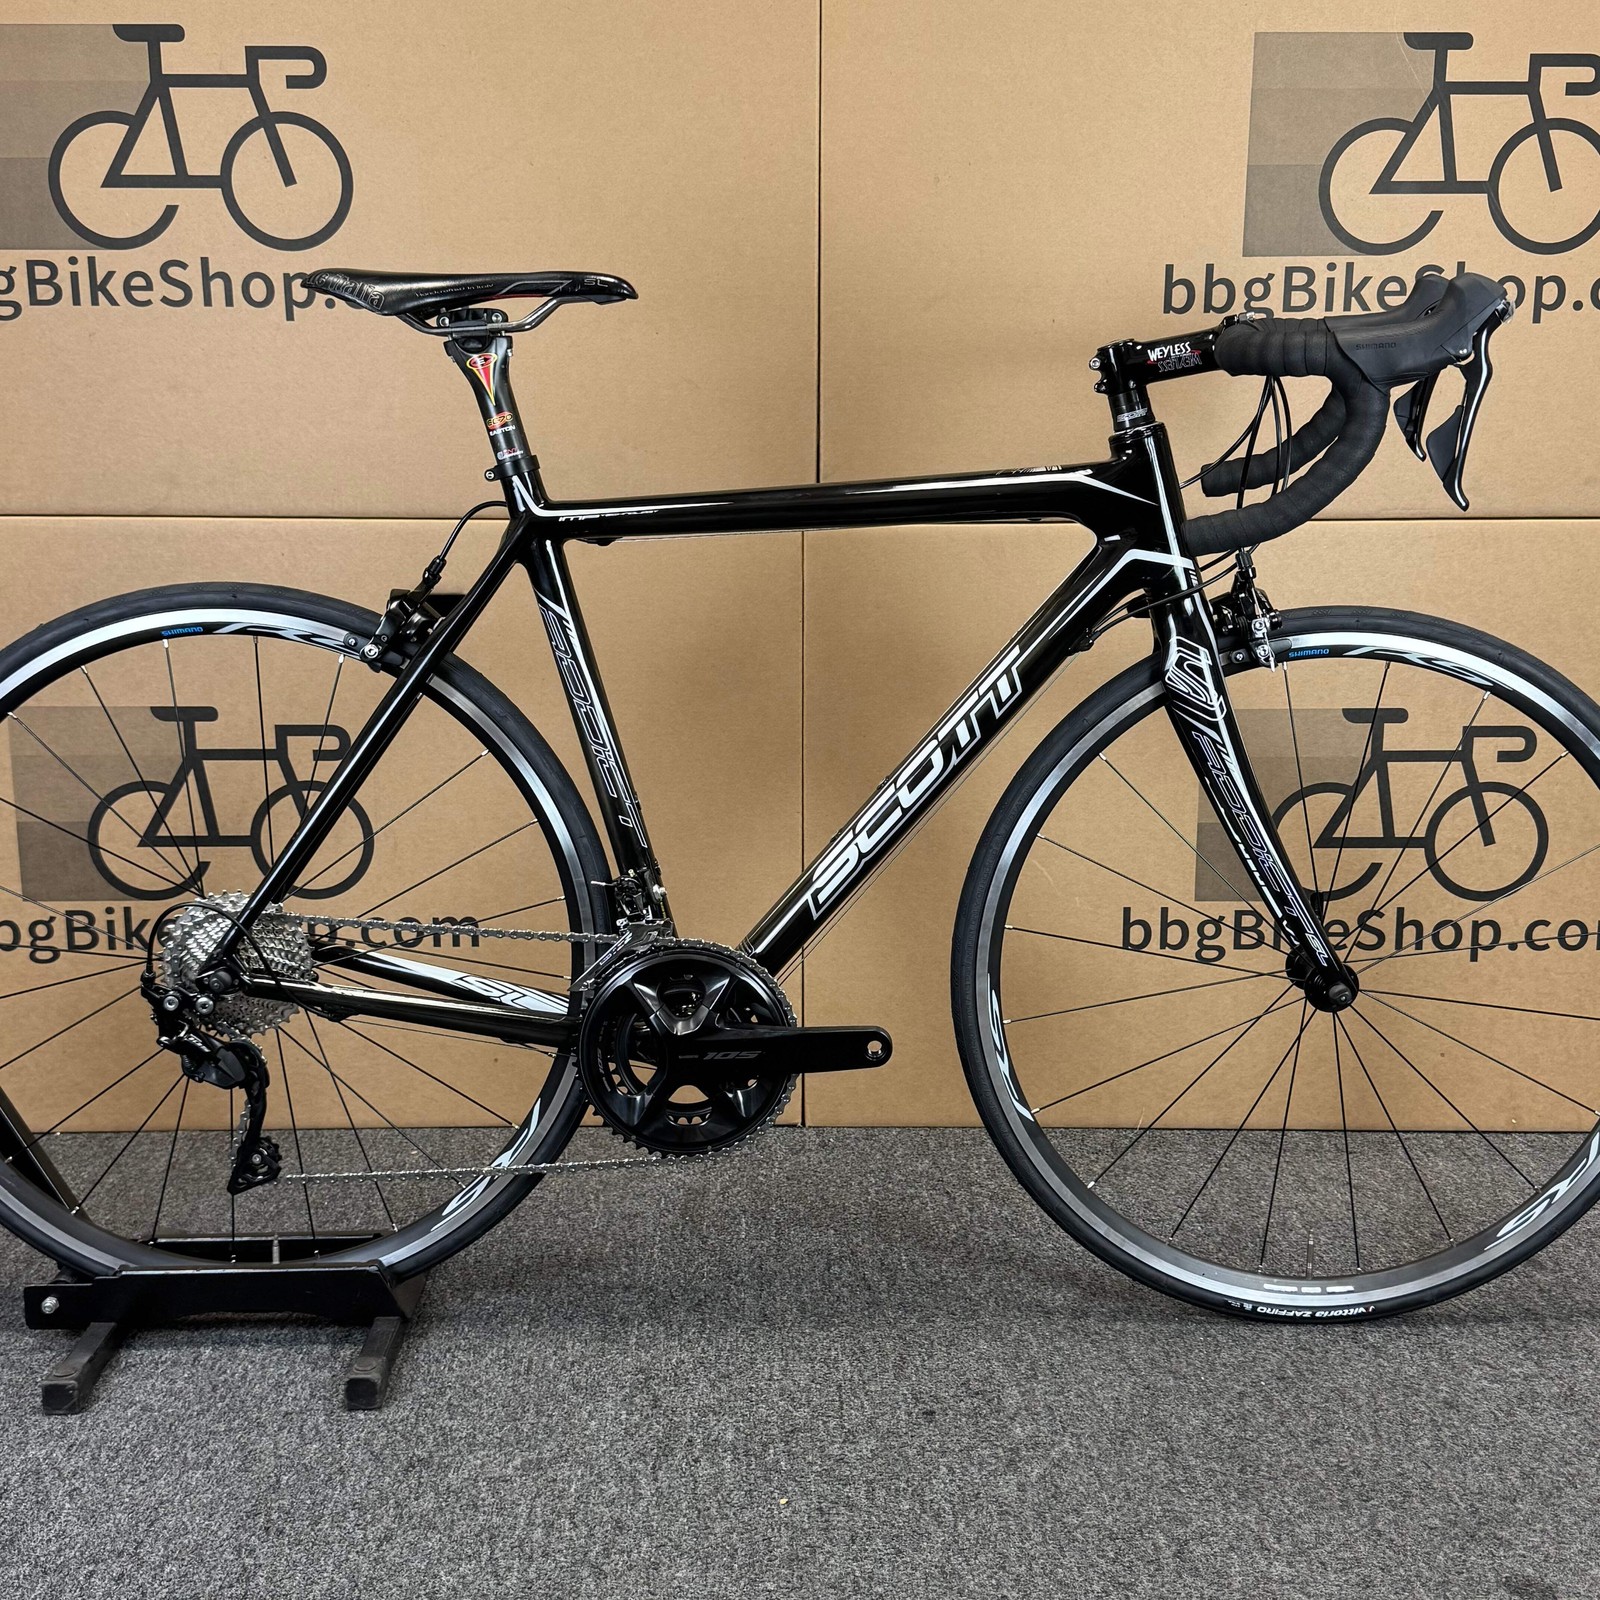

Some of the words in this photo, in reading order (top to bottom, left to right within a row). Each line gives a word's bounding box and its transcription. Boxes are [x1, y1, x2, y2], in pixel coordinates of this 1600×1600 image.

[0, 256, 366, 322] gBikeShop.
[1163, 261, 1600, 324] bbgBikeop.
[1147, 341, 1192, 361] WEYLESS
[1355, 342, 1397, 352] SHIMANO
[160, 626, 204, 637] SHIMANO
[1288, 648, 1330, 659] SHIMANO
[807, 644, 1022, 916] SCOTT
[1122, 907, 1600, 963] bbgBieShop.co
[703, 1050, 762, 1060] 105
[1256, 1305, 1313, 1318] ZAFFIRO
